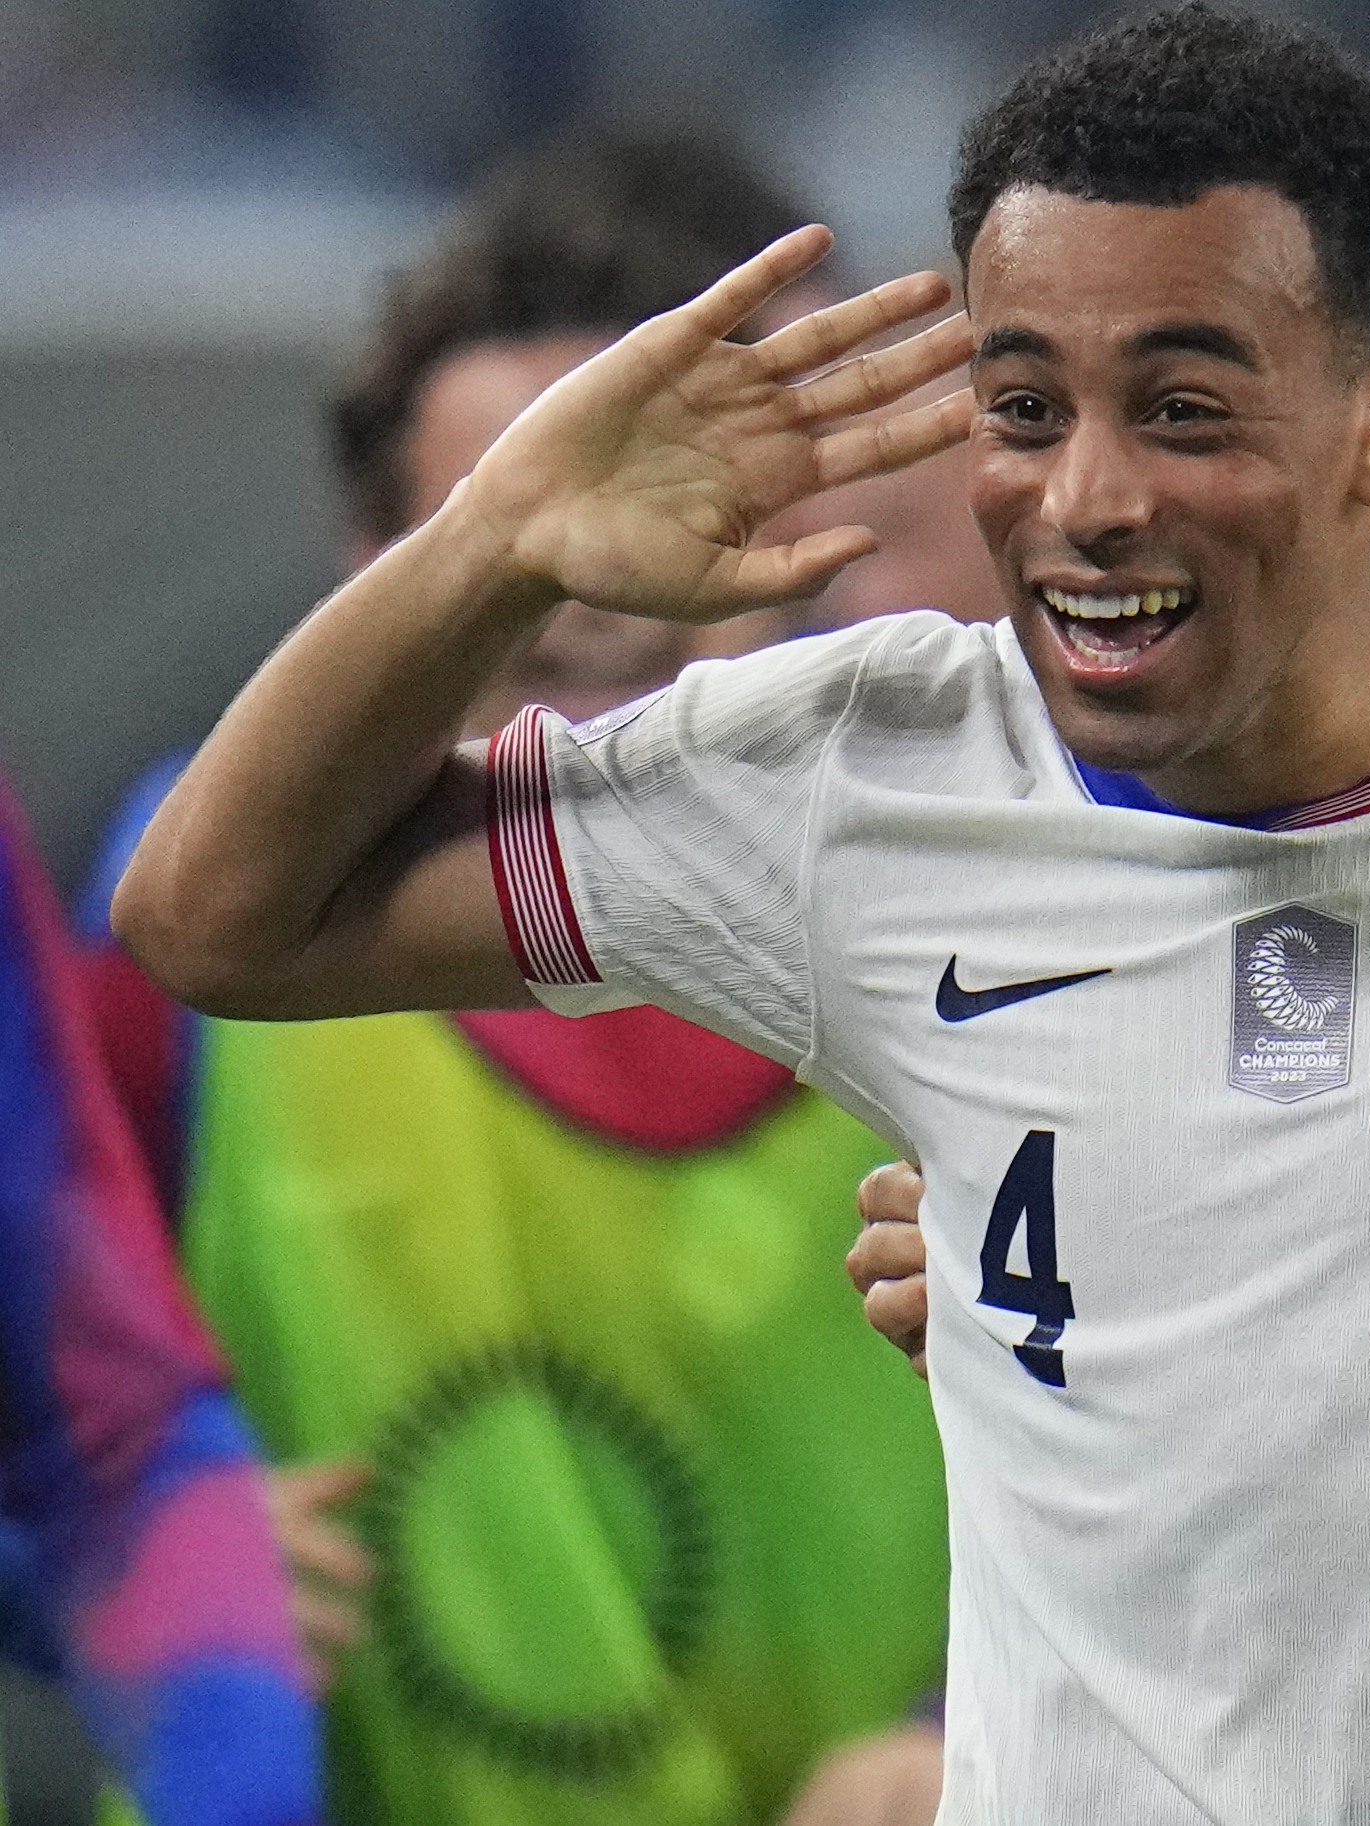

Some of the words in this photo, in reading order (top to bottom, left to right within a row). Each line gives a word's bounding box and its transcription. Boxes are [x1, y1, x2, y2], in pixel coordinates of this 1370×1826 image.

[1255, 1037, 1327, 1053] Concacaf
[1239, 1053, 1341, 1070] CHAMPIONS
[975, 1130, 1076, 1389] 4
